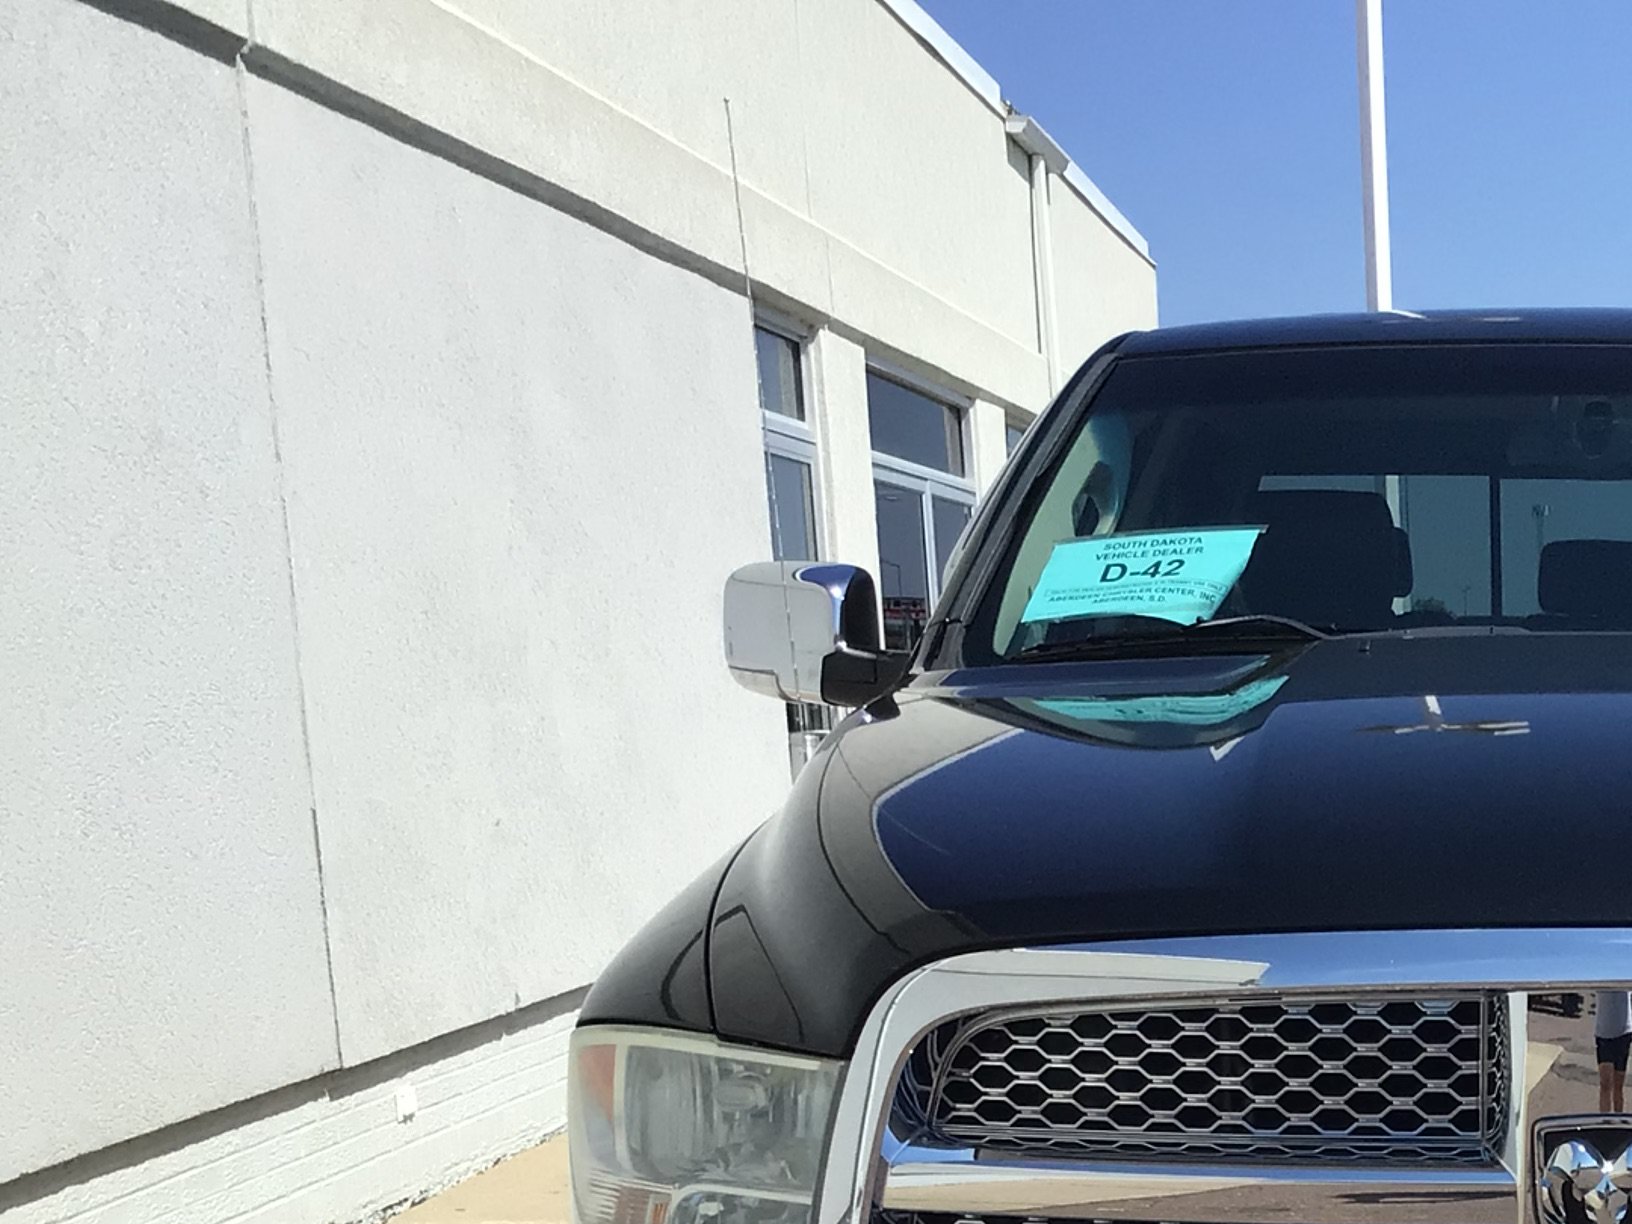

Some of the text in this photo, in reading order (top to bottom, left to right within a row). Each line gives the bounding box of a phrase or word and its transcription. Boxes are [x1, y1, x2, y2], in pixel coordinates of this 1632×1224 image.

[1103, 536, 1203, 551] SOUTH DAKOTA
[1095, 546, 1205, 561] VEHICLE DEALER
[1100, 558, 1186, 583] D-42
